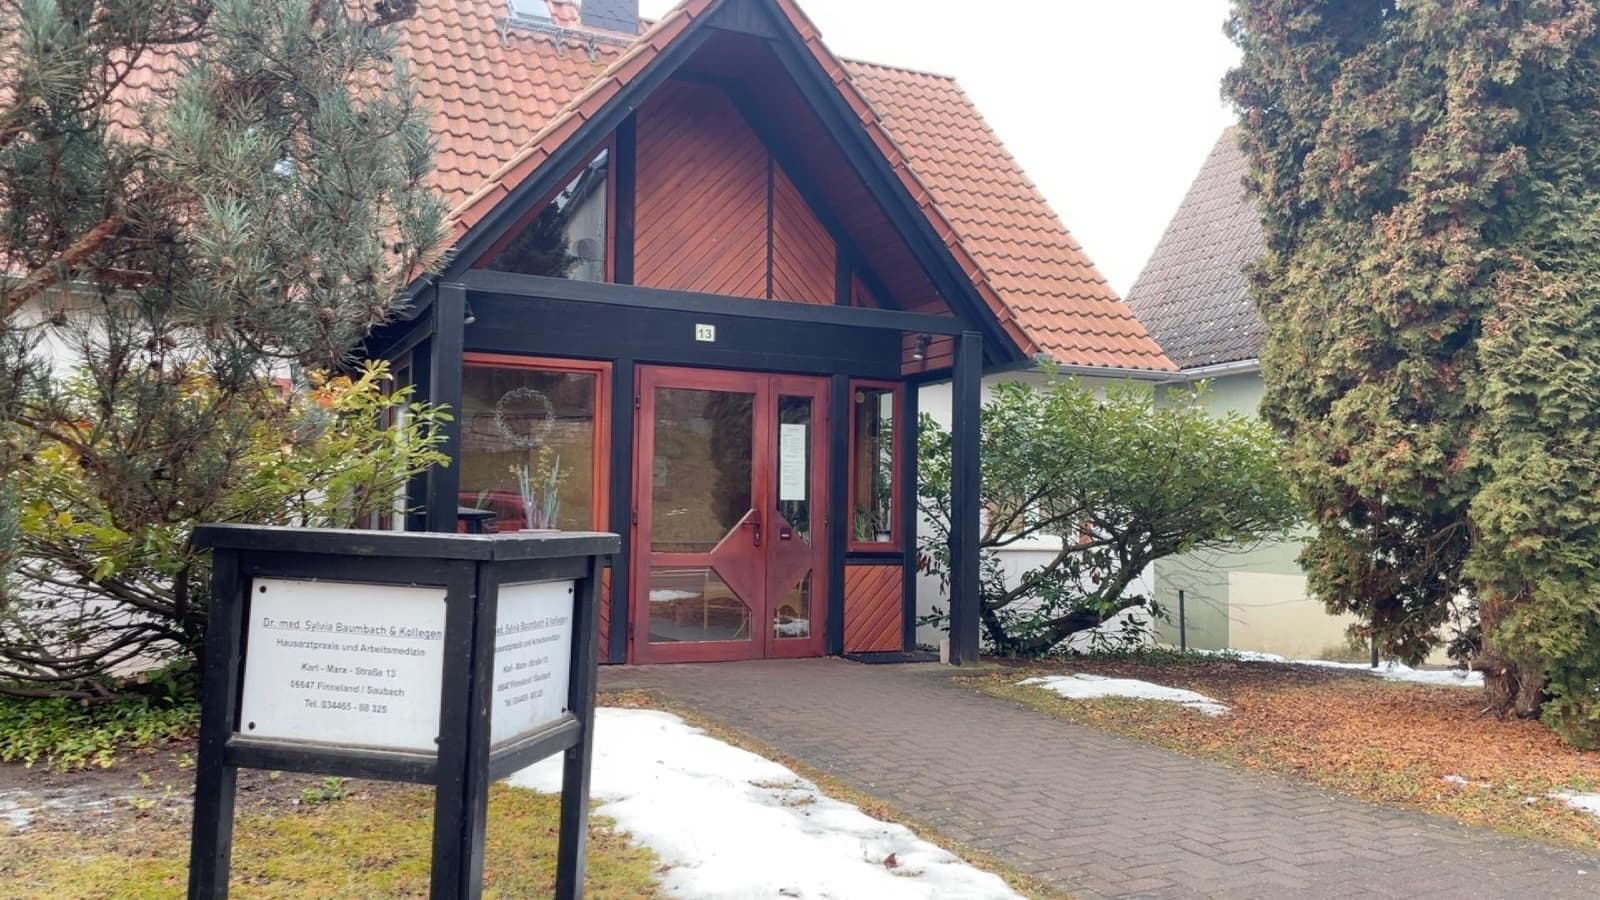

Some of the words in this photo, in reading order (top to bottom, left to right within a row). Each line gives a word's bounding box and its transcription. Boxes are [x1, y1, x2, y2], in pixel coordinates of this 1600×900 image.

[698, 328, 712, 339] 13
[304, 619, 333, 632] Sylvia
[335, 621, 387, 635] Baumbach
[388, 625, 397, 636] &
[399, 625, 442, 640] Kollegen
[276, 638, 340, 651] Hausarztpraxis
[341, 643, 358, 653] und
[360, 643, 426, 657] Arbeitsmedizin
[301, 662, 319, 673] Karl
[326, 664, 347, 675] Marx
[355, 666, 383, 678] Straße
[386, 668, 397, 679] 13
[317, 681, 360, 694] Finneland
[367, 685, 405, 697] Saubach
